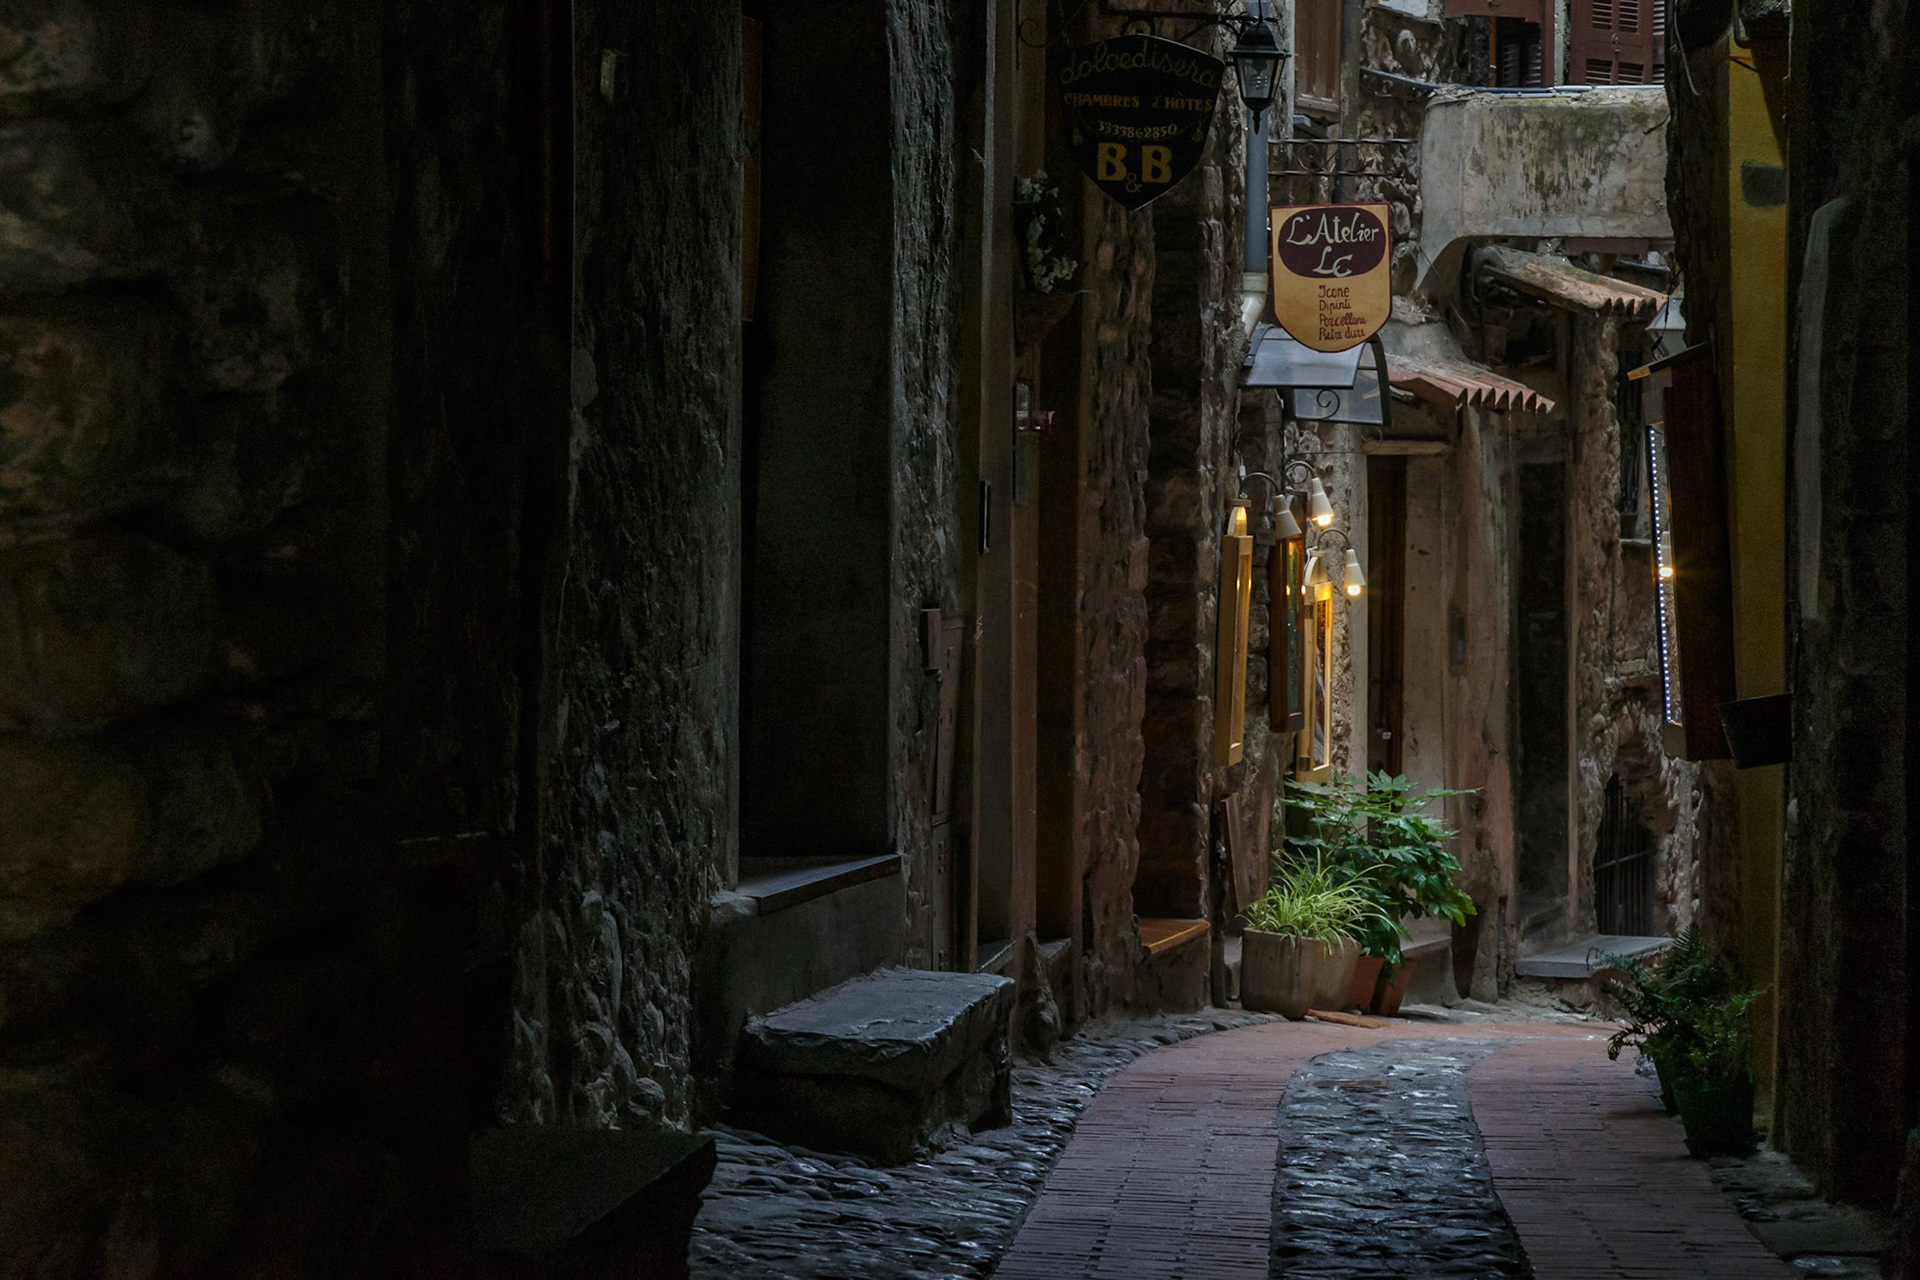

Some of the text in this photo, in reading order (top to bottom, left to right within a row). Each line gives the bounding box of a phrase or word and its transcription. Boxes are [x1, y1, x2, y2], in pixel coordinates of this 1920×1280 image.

[1064, 93, 1140, 109] CHAMBRES
[1286, 212, 1378, 245] L'Atelier
[1312, 246, 1353, 278] LC
